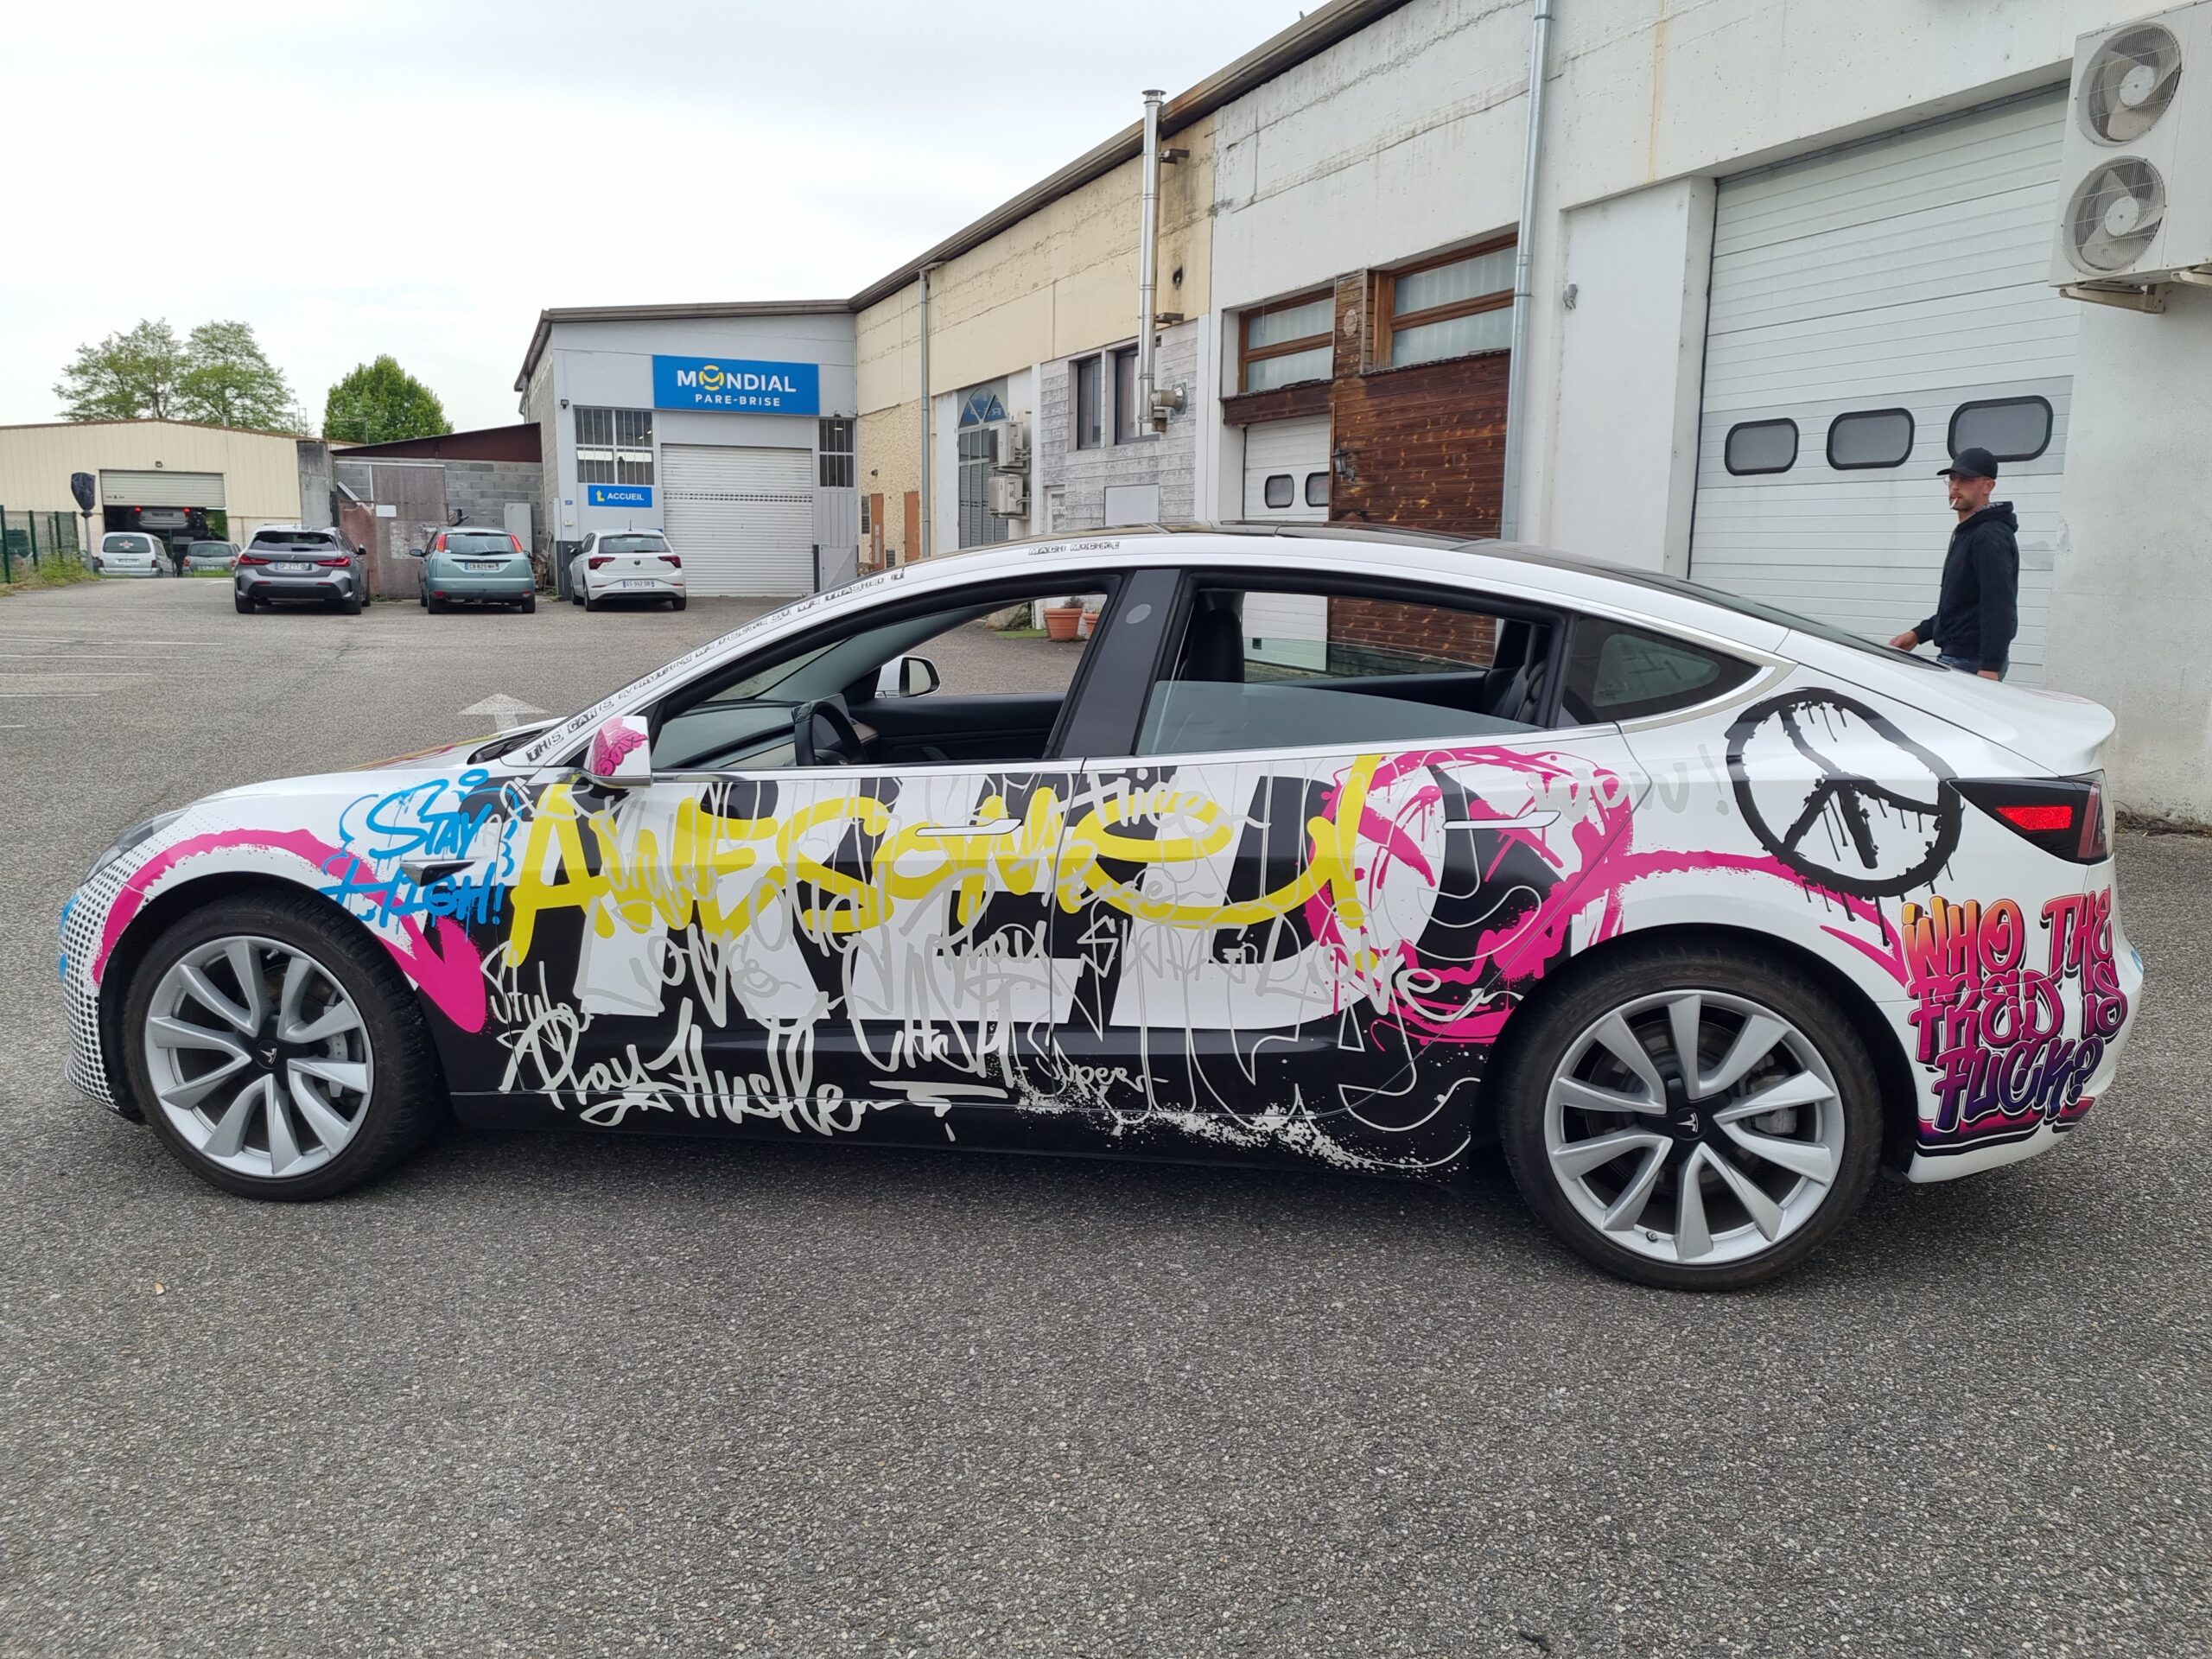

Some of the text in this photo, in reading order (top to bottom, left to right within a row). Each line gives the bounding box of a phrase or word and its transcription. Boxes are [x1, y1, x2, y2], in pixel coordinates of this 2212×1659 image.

[677, 365, 797, 392] MONDIAL
[695, 393, 781, 407] PARE-BRISE
[607, 492, 645, 501] ACCUEIL
[567, 707, 598, 734] CAR
[1902, 895, 2025, 977] WHO
